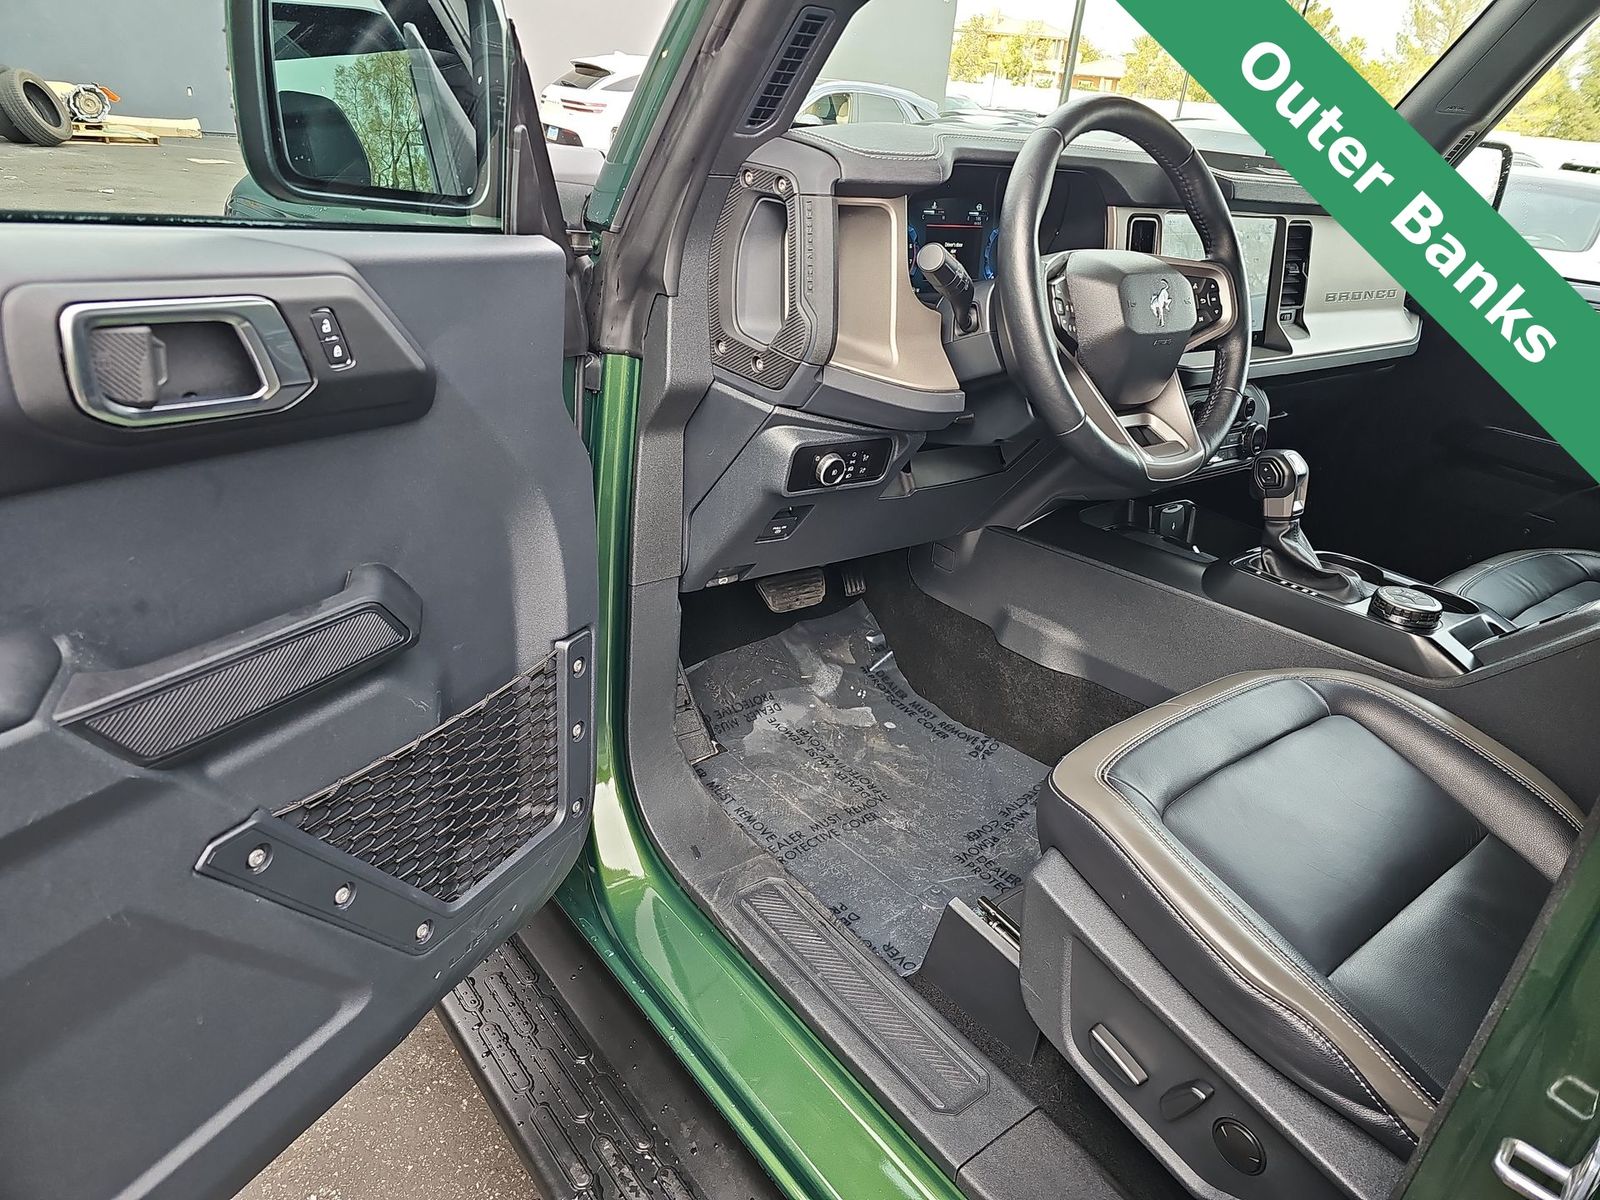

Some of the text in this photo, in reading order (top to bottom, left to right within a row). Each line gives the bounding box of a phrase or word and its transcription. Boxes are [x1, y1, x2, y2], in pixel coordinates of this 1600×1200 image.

[1325, 289, 1398, 302] BRONCO
[716, 691, 776, 719] PROTECTIVE
[867, 673, 950, 741] PROTECTIVE COVER
[874, 670, 907, 700] DEALER
[909, 701, 938, 720] MUST
[938, 721, 980, 746] REMOVE
[714, 720, 740, 736] MUS
[795, 727, 826, 752] COVER
[766, 717, 872, 800] DEALER MUST REMOVE
[734, 806, 778, 842] REMOVE
[768, 793, 891, 854] EALER MUST REMOVE
[962, 784, 1042, 842] OTECTIVE COVER
[778, 811, 880, 865] ROTECTIVE COVER
[953, 810, 1031, 864] MUST REMOVE
[975, 855, 1023, 886] DEALER
[882, 941, 918, 971] OVER
